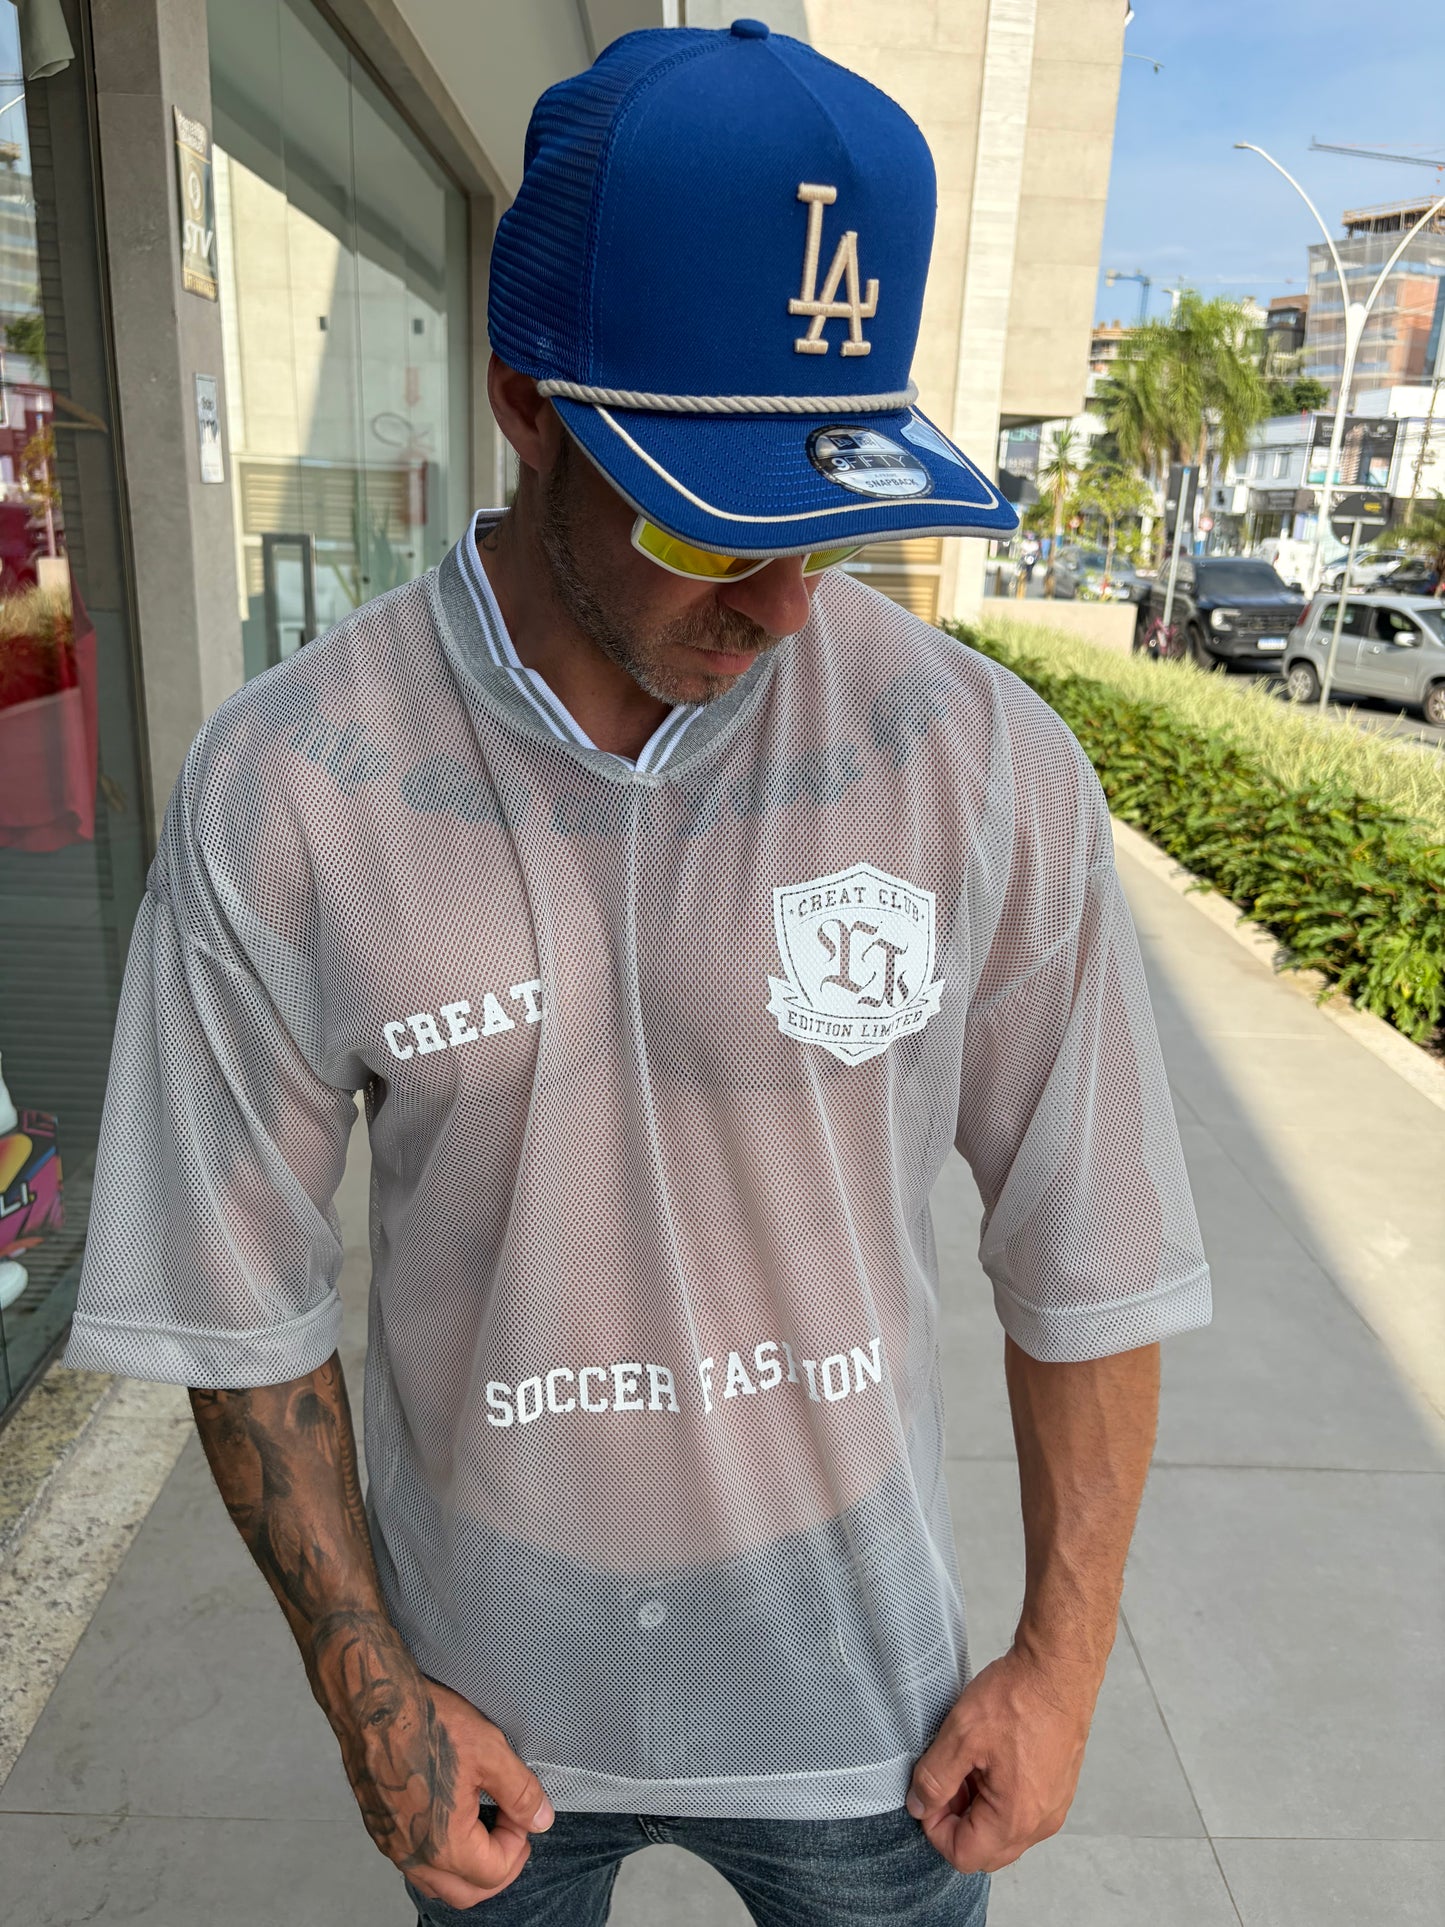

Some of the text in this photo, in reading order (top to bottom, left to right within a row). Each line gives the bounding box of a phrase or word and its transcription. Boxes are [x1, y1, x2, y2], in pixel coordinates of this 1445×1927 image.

[182, 218, 214, 259] STV
[788, 181, 880, 357] LA
[831, 454, 906, 471] 9FIFTY
[865, 478, 919, 488] SNAPBACK
[879, 888, 919, 922] CLUB
[384, 979, 542, 1060] CREAT
[788, 1010, 922, 1037] EDITION LIMITED
[486, 1363, 681, 1427] SOCCER
